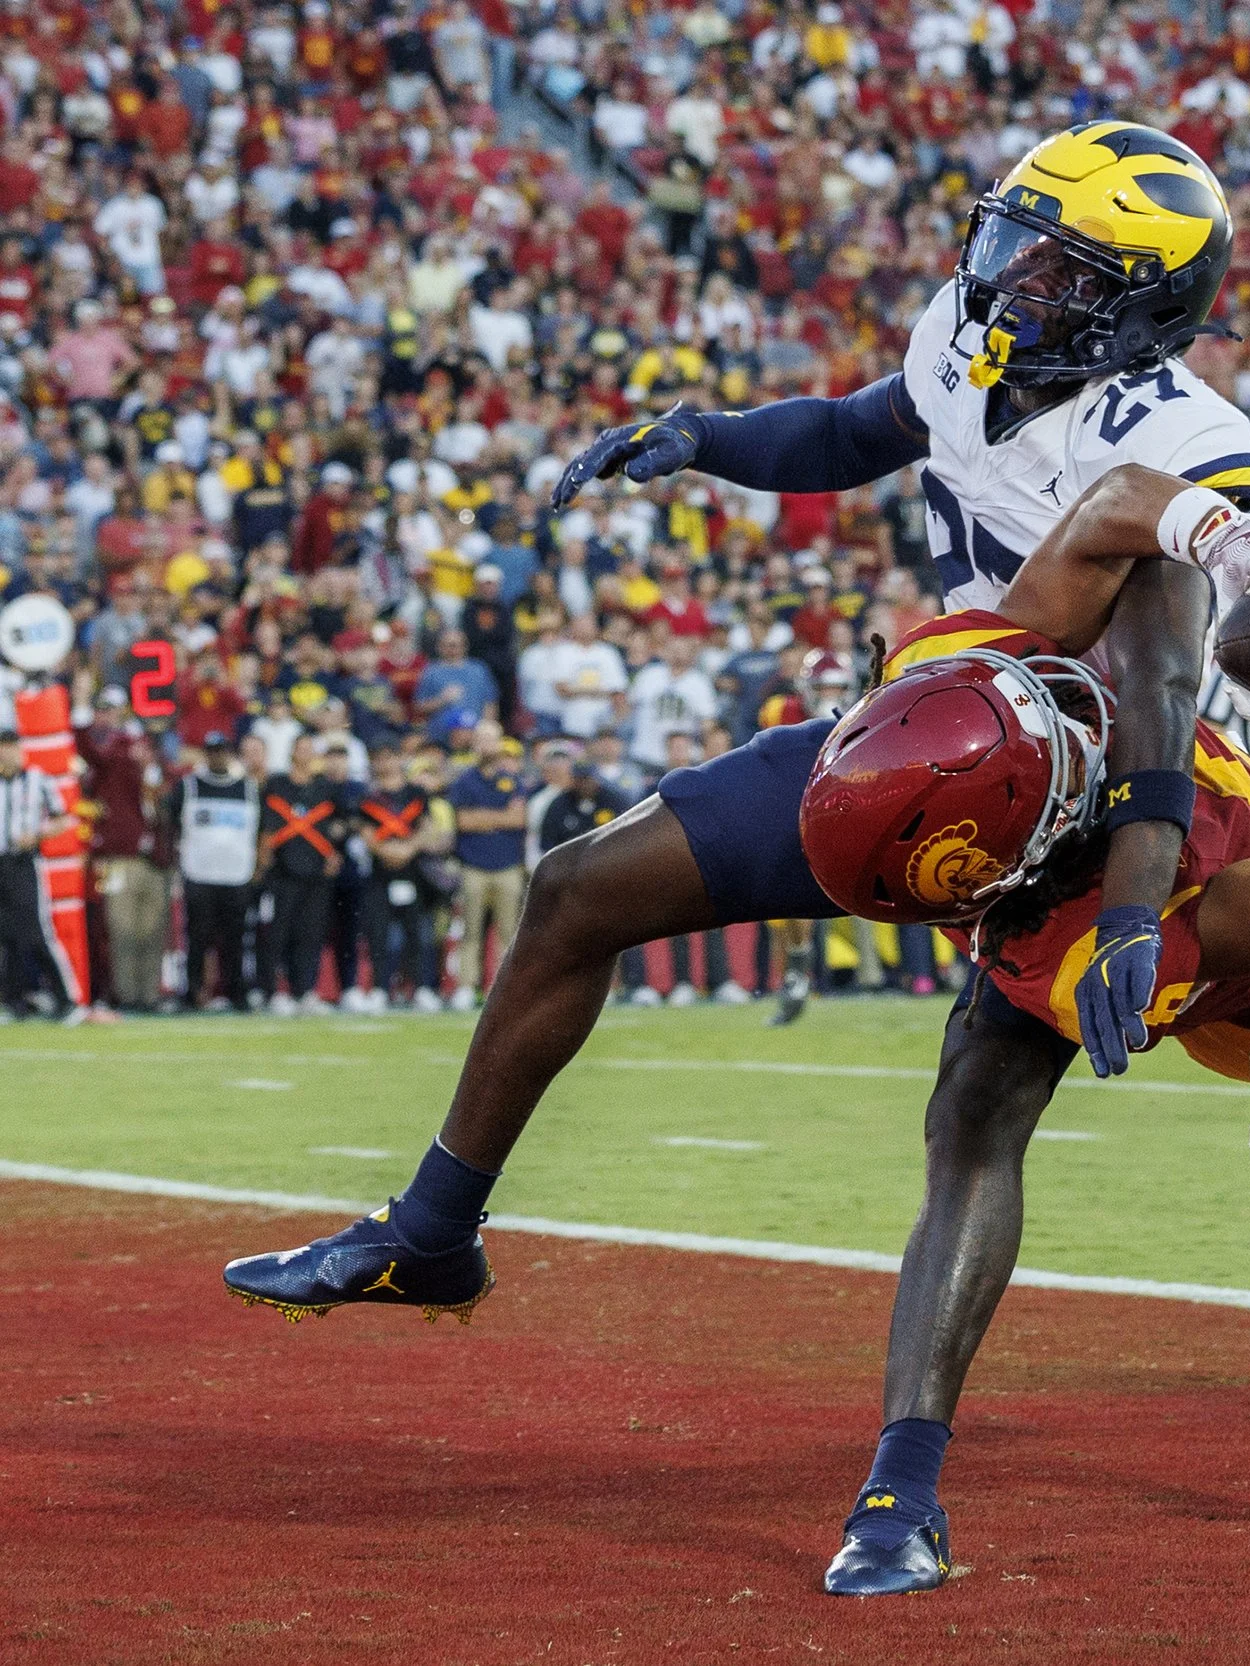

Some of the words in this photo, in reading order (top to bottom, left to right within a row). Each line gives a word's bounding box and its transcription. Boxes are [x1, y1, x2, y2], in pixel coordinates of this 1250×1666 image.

[1019, 191, 1040, 209] M
[1082, 367, 1191, 447] 27
[130, 640, 177, 718] 2
[1107, 781, 1132, 809] M
[866, 1495, 896, 1509] M
